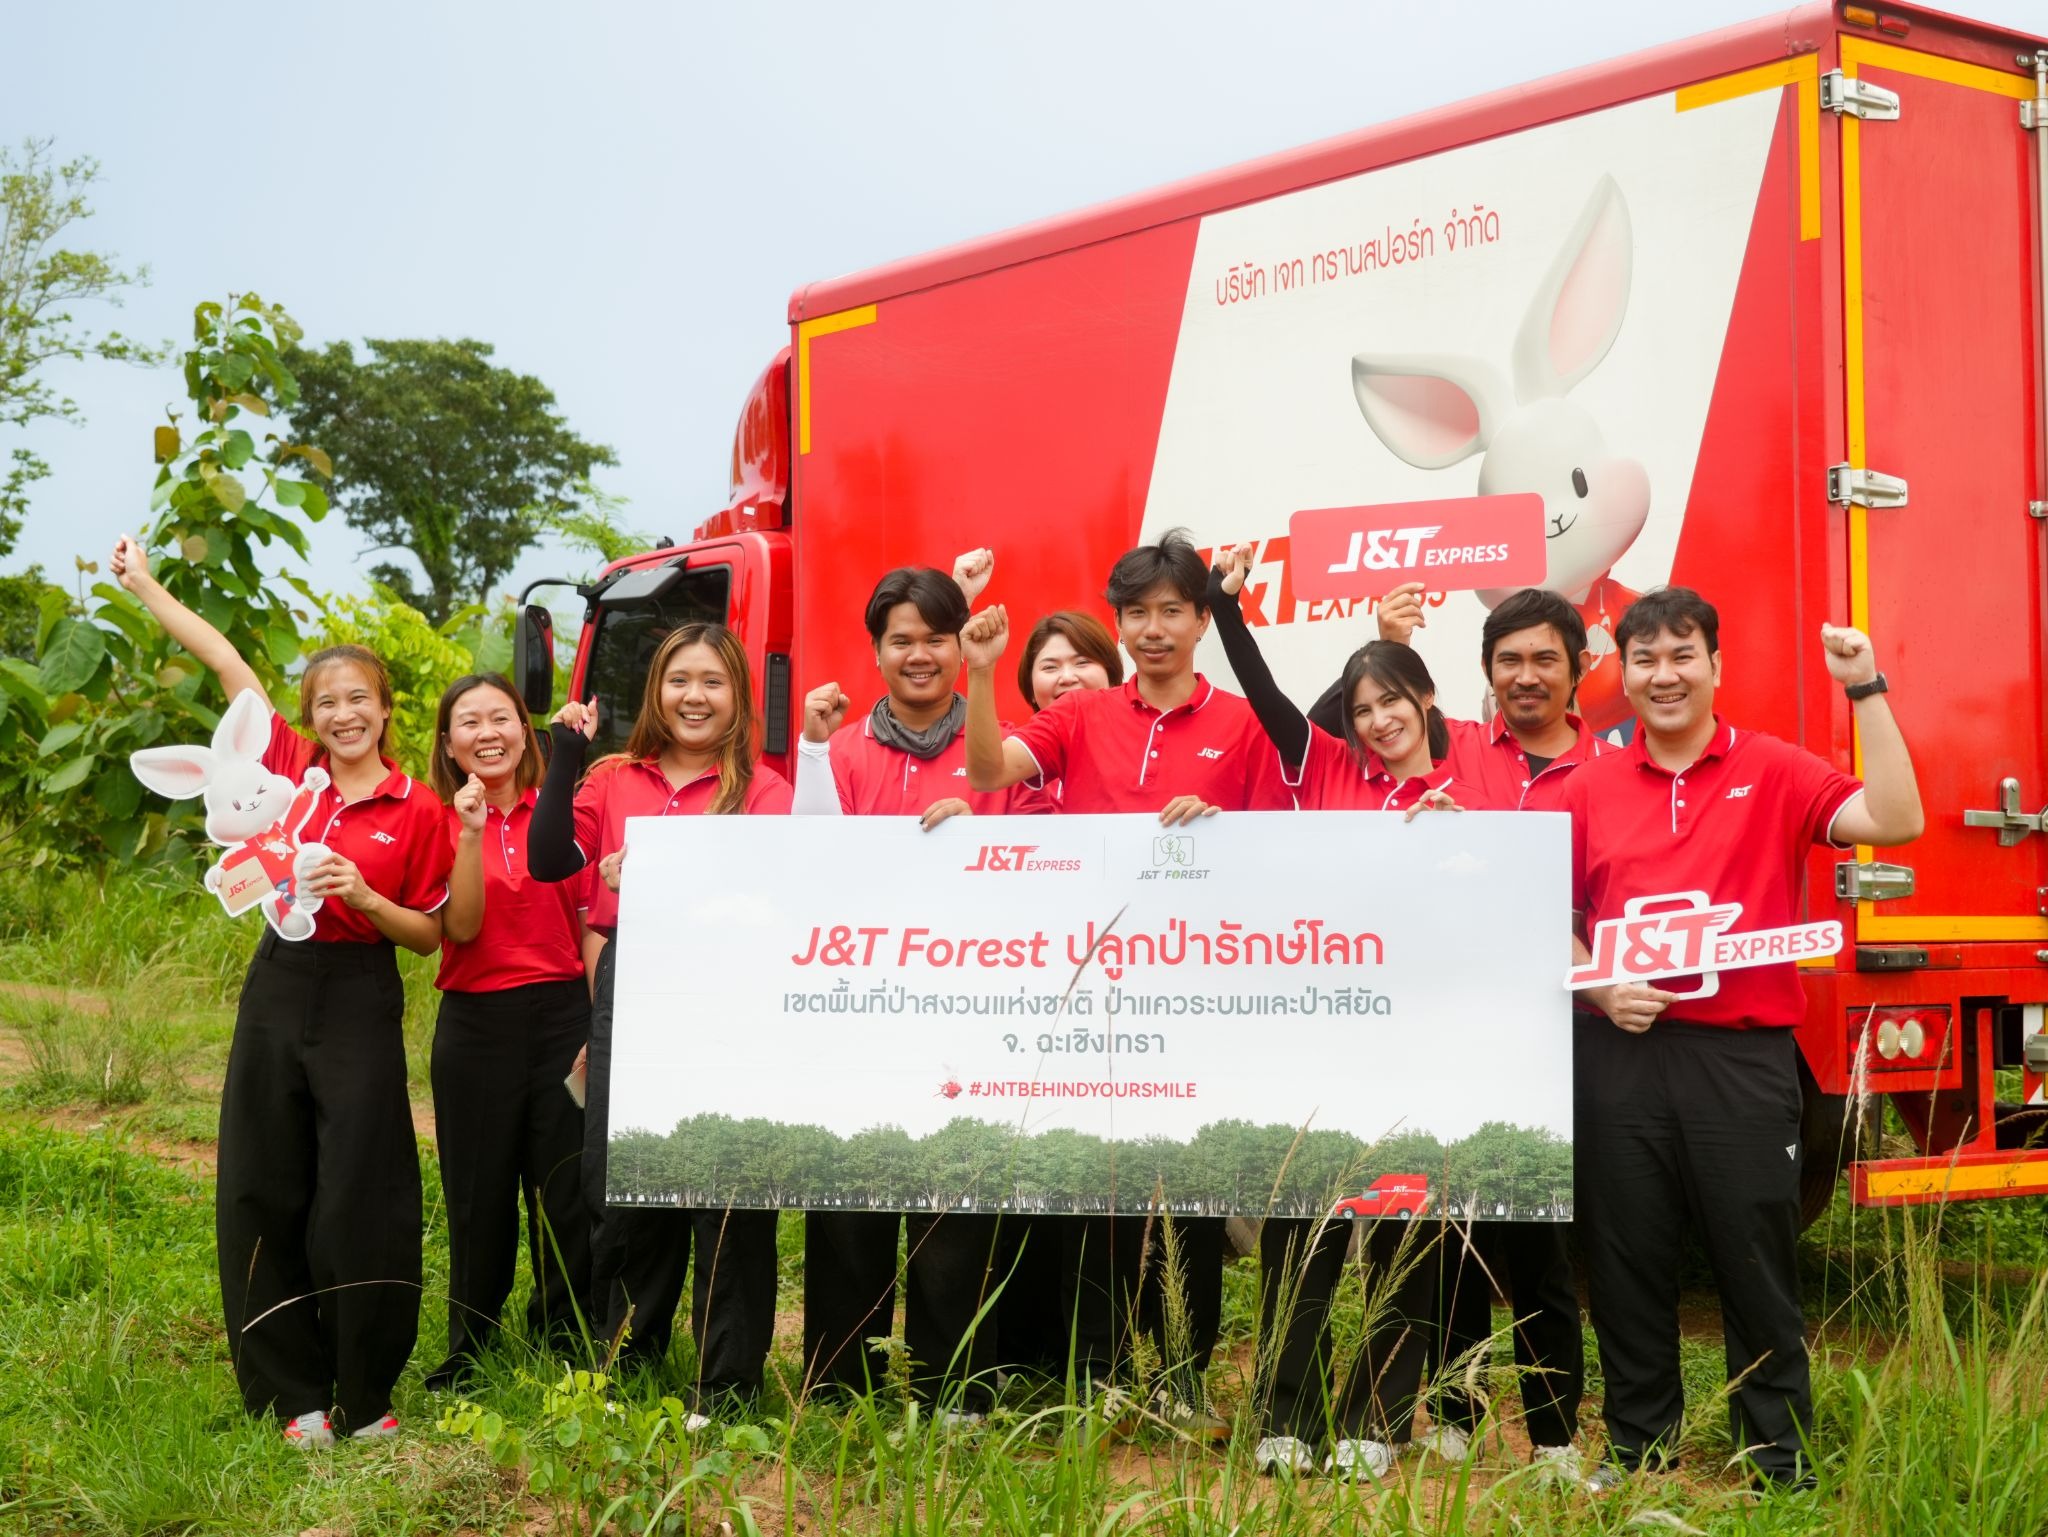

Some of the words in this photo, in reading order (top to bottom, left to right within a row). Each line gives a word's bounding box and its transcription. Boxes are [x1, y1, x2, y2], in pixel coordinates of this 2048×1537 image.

[1216, 261, 1266, 306] บริษัท
[1273, 258, 1304, 292] เจท
[1312, 218, 1434, 284] ทรานสปอร์ท
[1443, 204, 1500, 252] จำกัด
[1327, 526, 1443, 573] J&T
[1424, 544, 1509, 567] EXPRESS
[1197, 747, 1225, 759] J&T
[1725, 784, 1753, 799] J&T
[370, 831, 397, 845] J&T
[964, 845, 1040, 872] J&T
[1026, 859, 1082, 872] EXPRESS
[1136, 870, 1161, 880] J&T
[1164, 869, 1211, 880] FOREST
[791, 925, 889, 967] J&T
[898, 927, 1050, 968] Forest
[1067, 917, 1384, 981] ปลูกป่ารักษ์โลก
[1570, 908, 1736, 984] J&T
[1713, 926, 1836, 964] EXPRESS
[783, 977, 1094, 1016] เขตพื้นที่ป่าสงวนแห่งชาติ
[1104, 985, 1392, 1016] ป่าแควระบมและป่าสียัด
[1002, 1033, 1026, 1053] จ.
[1036, 1028, 1165, 1054] ฉะเชิงเทรา
[969, 1081, 1197, 1098] #JNTBEHINDYOURSMILE
